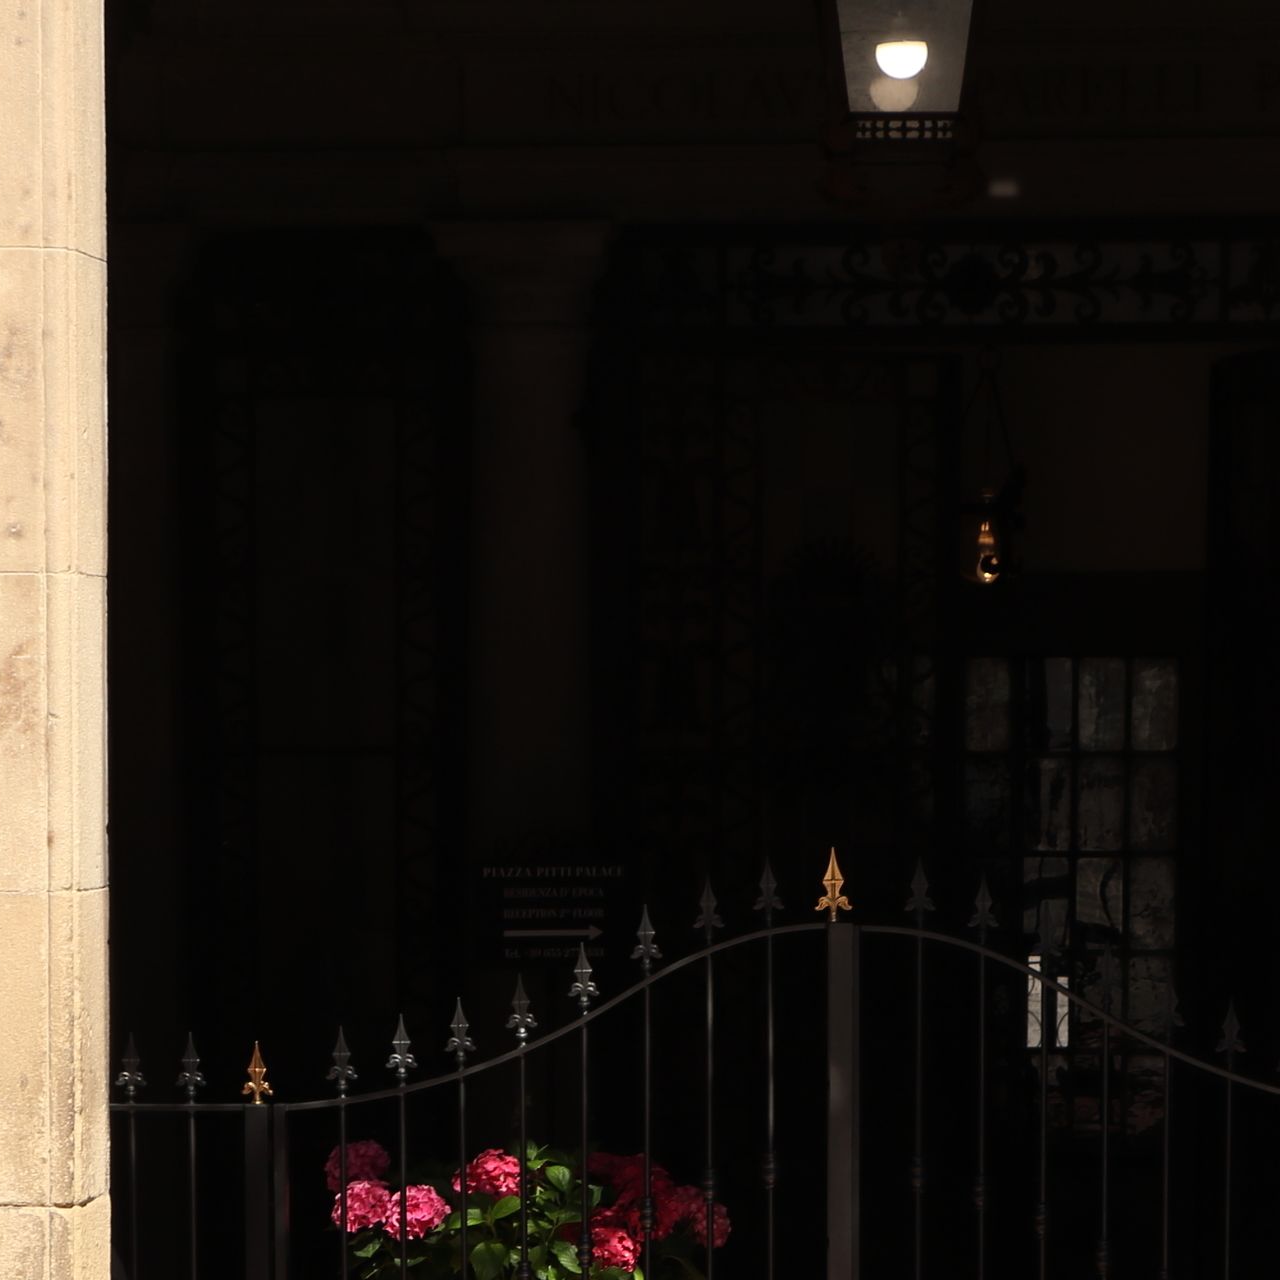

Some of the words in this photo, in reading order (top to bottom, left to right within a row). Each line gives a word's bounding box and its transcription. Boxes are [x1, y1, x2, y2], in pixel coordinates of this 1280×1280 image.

[482, 866, 532, 878] PIAZZA
[536, 866, 572, 878] PITTI
[575, 865, 624, 878] PALACE
